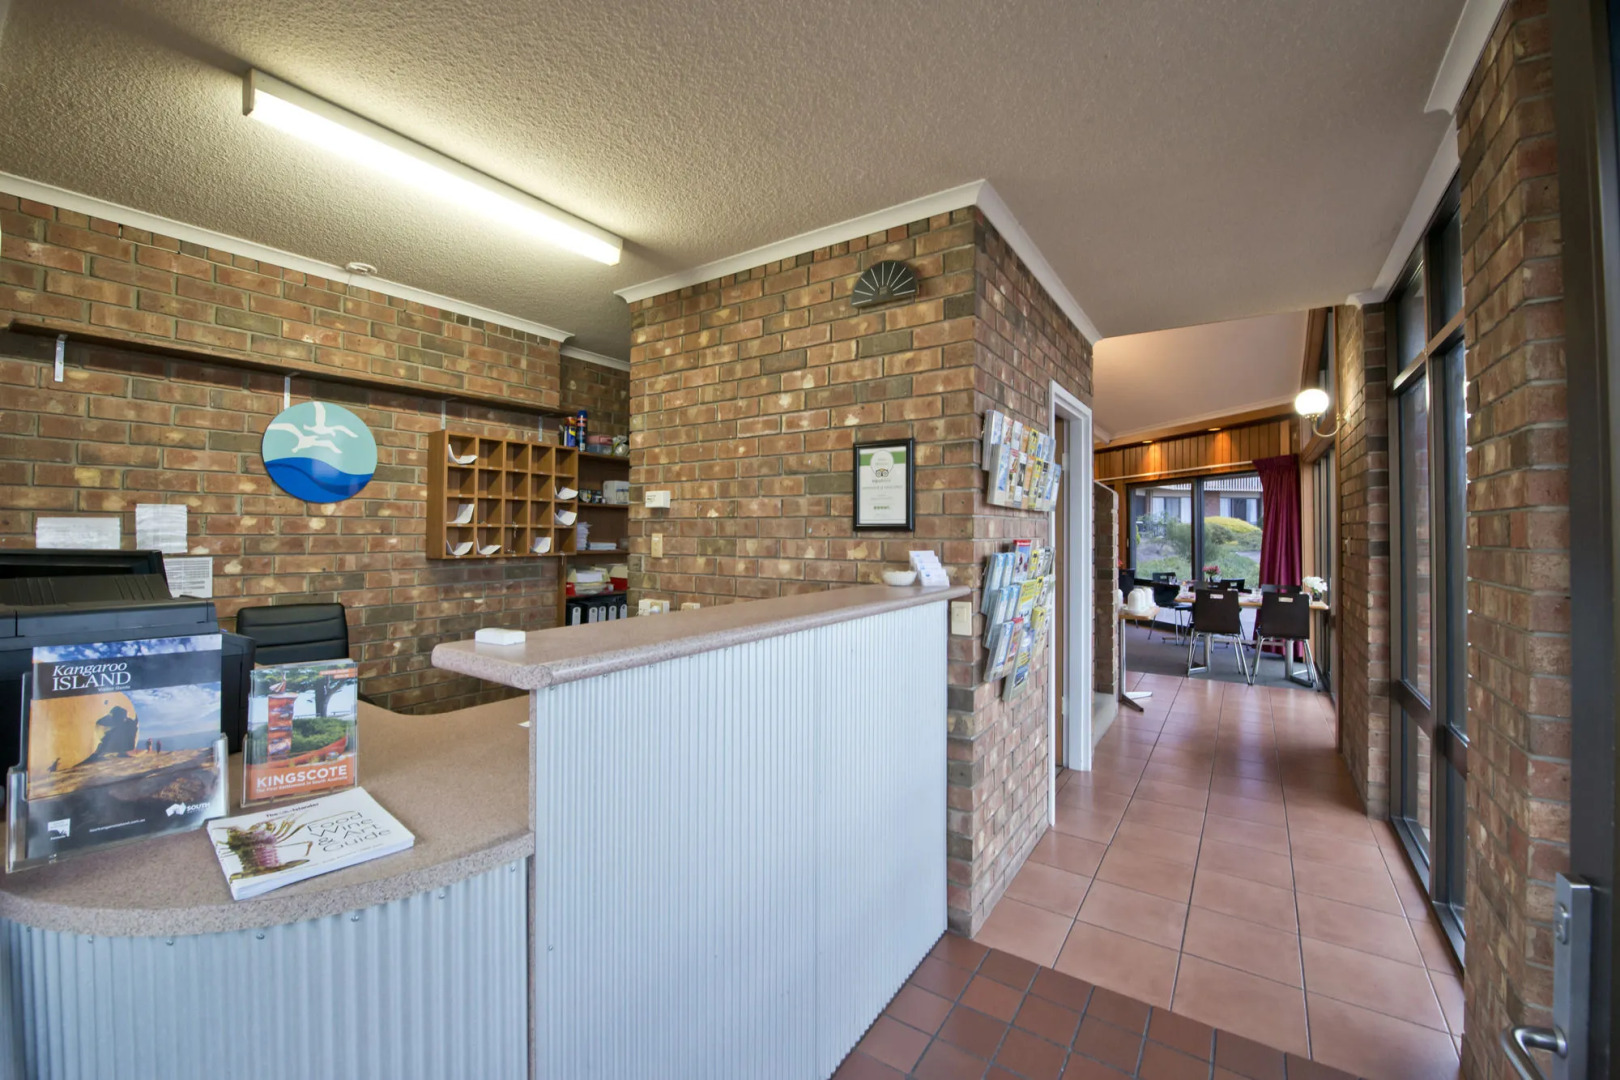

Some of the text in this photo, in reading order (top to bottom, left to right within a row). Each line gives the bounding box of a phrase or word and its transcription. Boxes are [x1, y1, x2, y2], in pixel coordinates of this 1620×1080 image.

[52, 662, 127, 677] Kangaroo
[52, 671, 131, 691] ISLAND
[256, 765, 347, 788] KINGSCOTE
[186, 802, 211, 812] SOUTH
[307, 812, 363, 832] Food
[310, 818, 374, 837] Wine
[343, 823, 380, 840] Art
[323, 830, 391, 852] Guide
